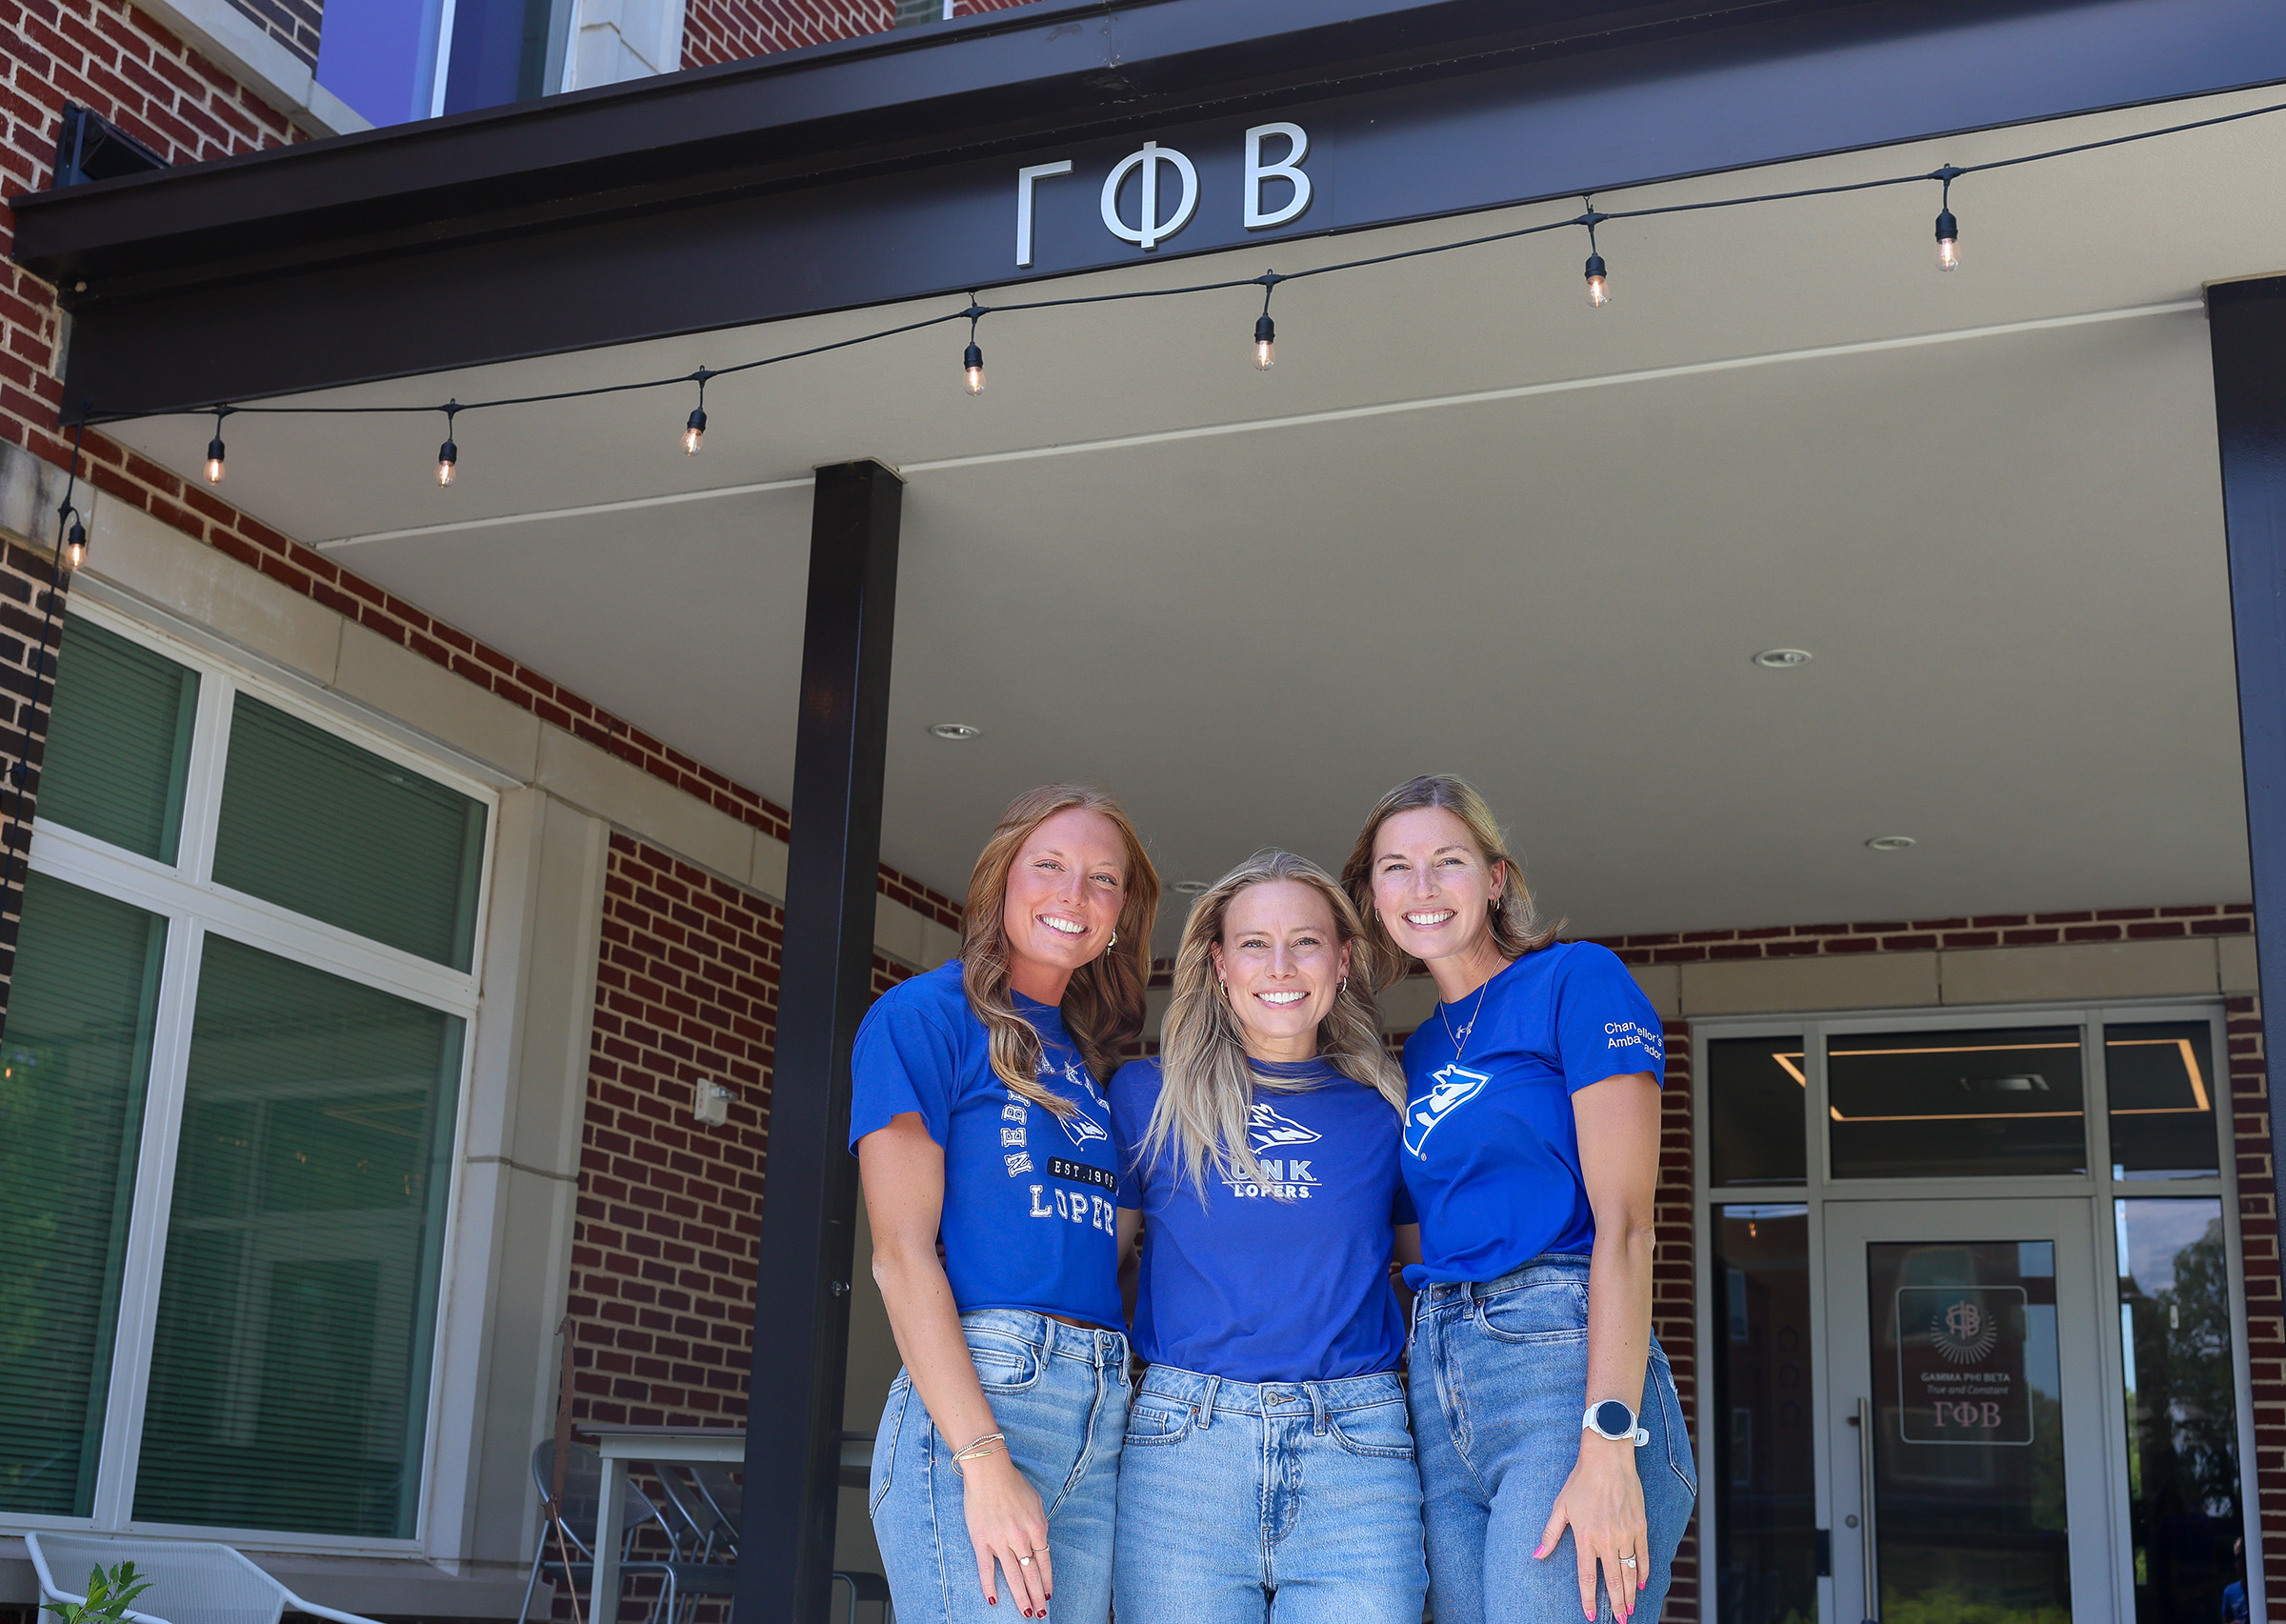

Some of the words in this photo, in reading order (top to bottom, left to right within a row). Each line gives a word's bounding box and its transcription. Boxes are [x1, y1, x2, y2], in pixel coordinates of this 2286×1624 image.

[1604, 1021, 1663, 1048] Chanellor's
[1607, 1034, 1662, 1060] Ambaador
[1920, 1372, 1962, 1382] GAMMA
[1963, 1373, 1982, 1382] PHI
[1983, 1373, 2012, 1383] BETA
[1927, 1384, 1946, 1394] True
[1948, 1385, 1966, 1395] and
[1967, 1385, 2010, 1395] Constant
